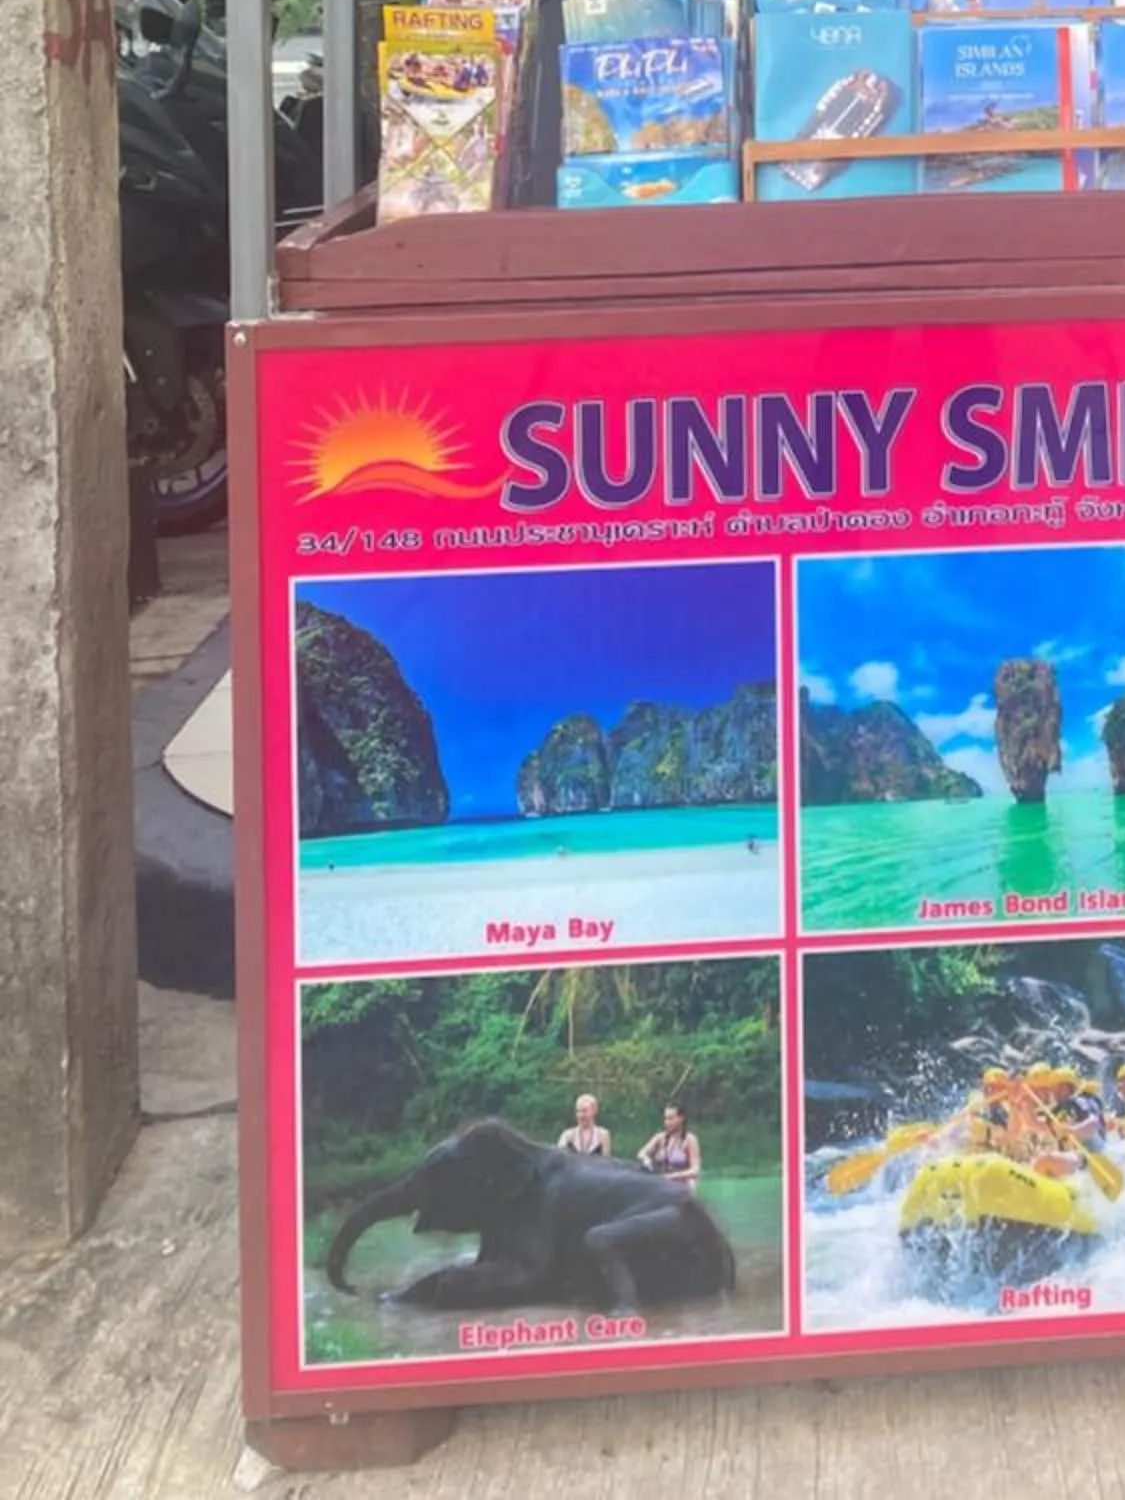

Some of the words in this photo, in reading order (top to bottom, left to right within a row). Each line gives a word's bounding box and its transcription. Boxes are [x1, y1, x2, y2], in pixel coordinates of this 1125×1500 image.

[392, 9, 485, 31] RAFTING
[956, 43, 1025, 60] SIMILAN
[955, 60, 1026, 78] ISLANDS
[500, 388, 916, 512] SUNNY
[297, 526, 422, 554] 34/148
[918, 897, 994, 920] James
[1004, 890, 1068, 915] Bond
[484, 921, 557, 948] Maya
[567, 916, 615, 943] Bay
[1000, 1282, 1093, 1311] Rafting
[459, 1315, 577, 1352] Elephant
[585, 1314, 646, 1341] Care
